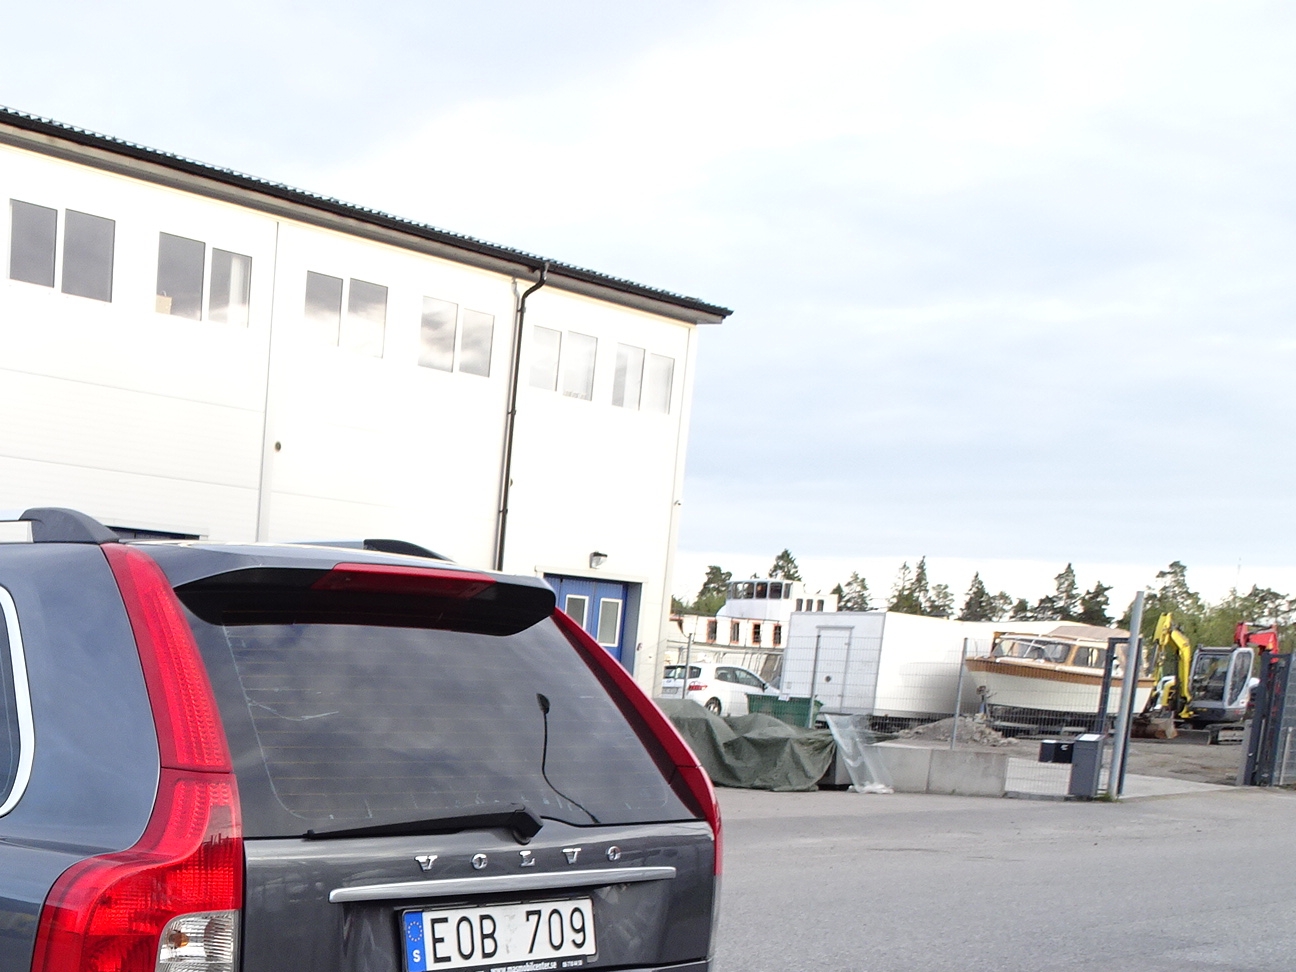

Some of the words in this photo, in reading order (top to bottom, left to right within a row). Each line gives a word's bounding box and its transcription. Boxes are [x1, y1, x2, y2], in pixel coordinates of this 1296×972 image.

[414, 845, 622, 872] VOLVO
[412, 949, 421, 963] S
[430, 914, 498, 964] EOB
[525, 907, 587, 954] 709
